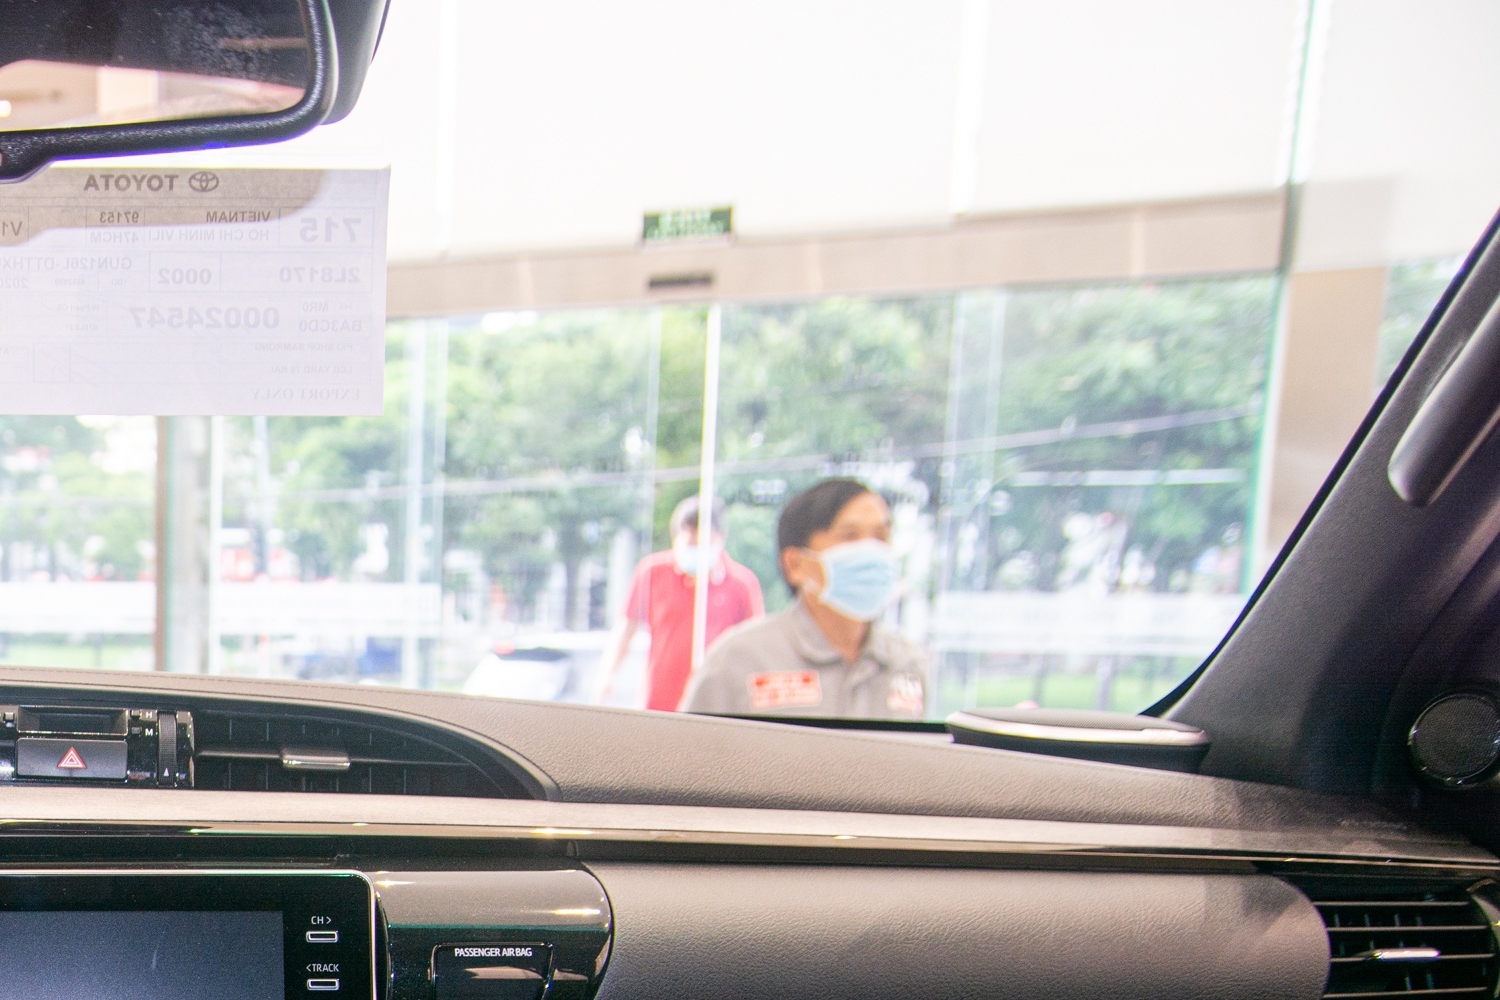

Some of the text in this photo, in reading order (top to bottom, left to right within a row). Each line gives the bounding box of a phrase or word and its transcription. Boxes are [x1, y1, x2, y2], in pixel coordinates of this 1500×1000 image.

[145, 711, 153, 719] H
[145, 728, 154, 737] M
[310, 916, 324, 925] CH
[454, 947, 501, 957] PASSENGER
[311, 964, 339, 972] TRACK
